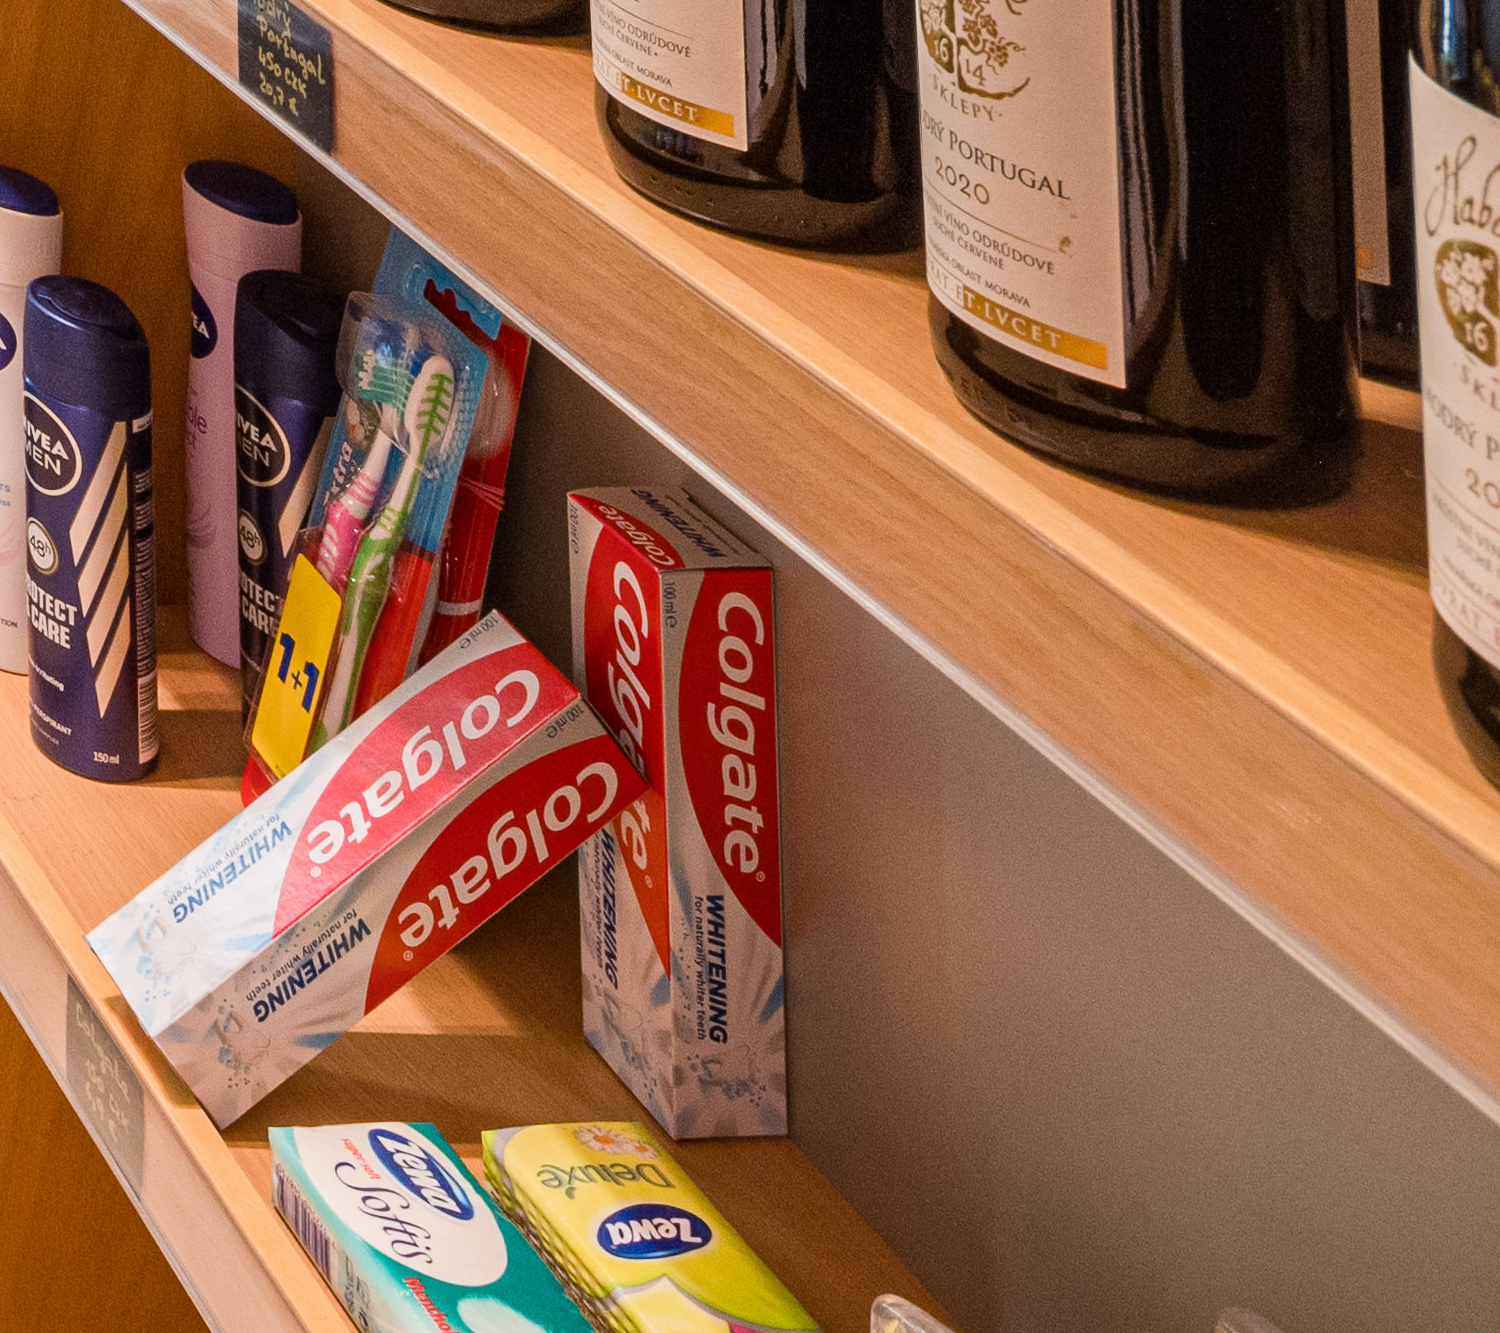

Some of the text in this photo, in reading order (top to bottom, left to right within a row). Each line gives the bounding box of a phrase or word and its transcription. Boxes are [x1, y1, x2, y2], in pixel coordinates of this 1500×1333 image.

[256, 15, 325, 85] Portugal
[931, 74, 994, 123] SKLEPY
[934, 156, 991, 206] 2020
[949, 125, 1072, 201] PORTUGAL
[32, 612, 71, 650] CARE
[307, 669, 541, 865] Colgate
[708, 591, 768, 875] Colgate
[173, 821, 293, 925] WHITENING
[399, 761, 619, 950] Colgate
[254, 916, 372, 1023] WHITENING
[707, 894, 728, 1044] WHITENING
[334, 1161, 434, 1266] Softis
[378, 1135, 462, 1219] Zewa
[537, 1162, 676, 1200] Deluxe
[607, 1214, 704, 1252] Zewa
